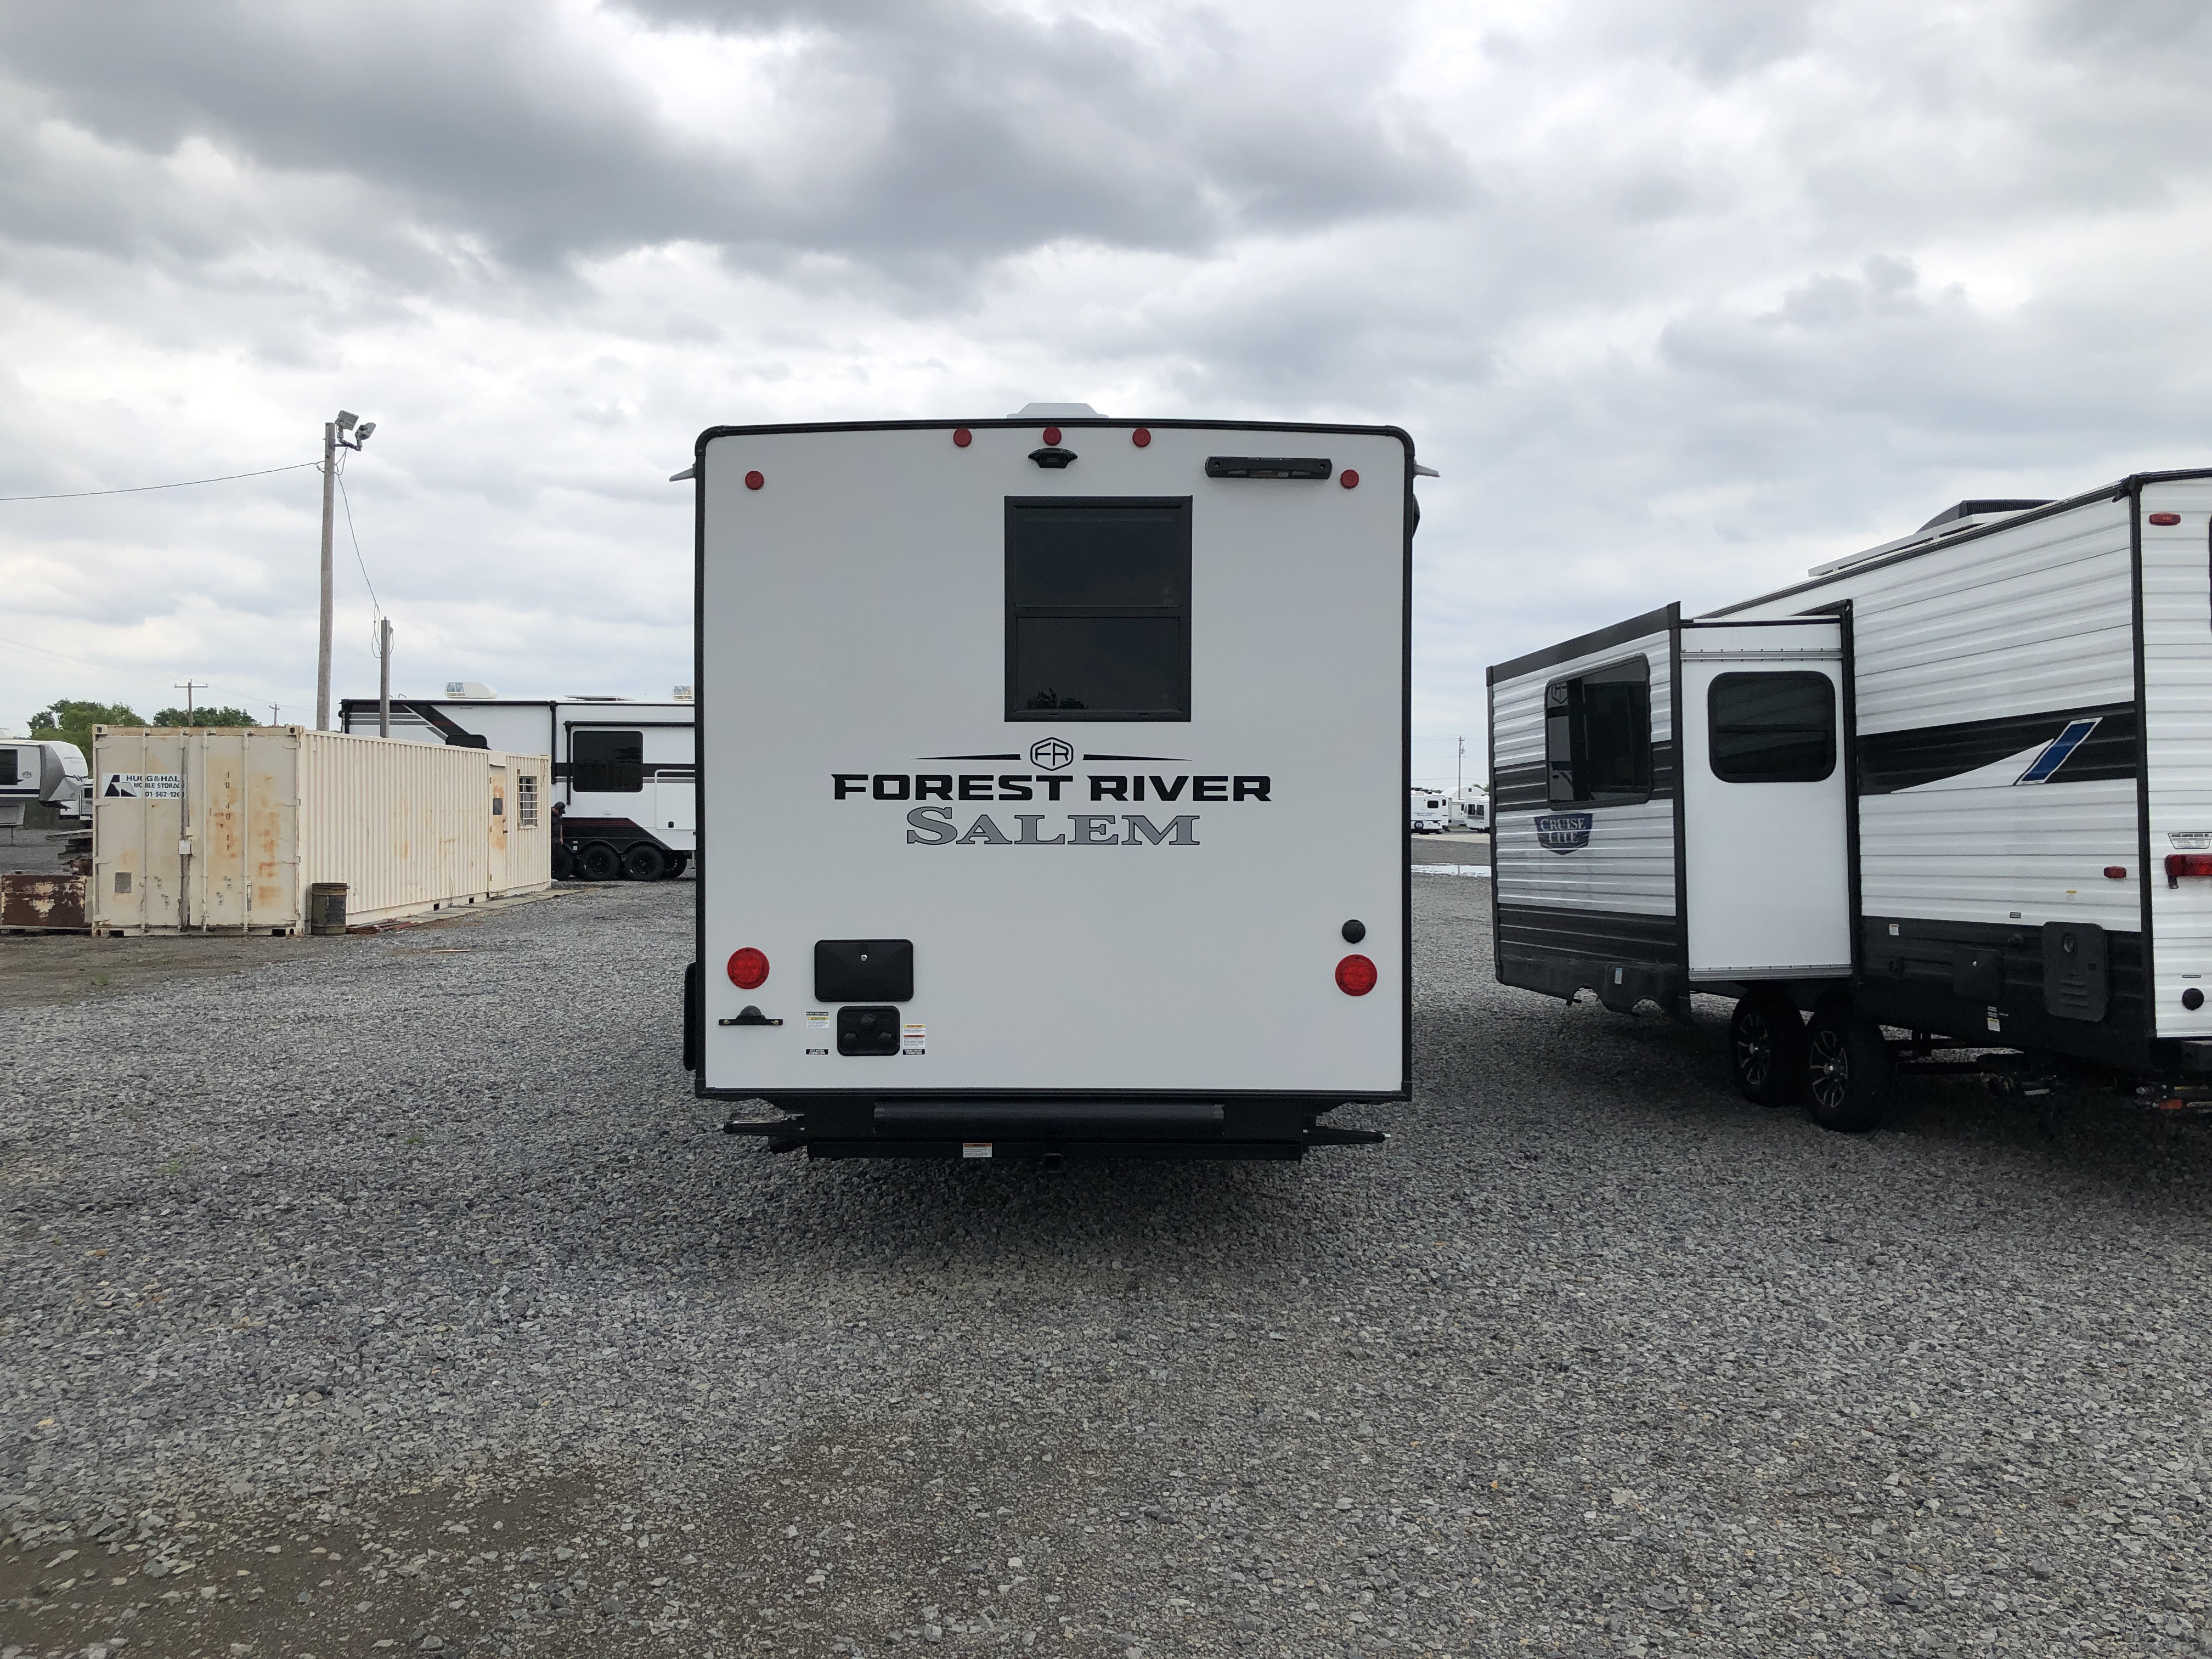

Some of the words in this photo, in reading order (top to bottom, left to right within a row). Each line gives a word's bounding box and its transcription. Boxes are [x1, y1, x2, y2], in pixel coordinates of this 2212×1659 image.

[1035, 742, 1069, 766] FR
[831, 774, 1074, 801] FOREST
[1087, 775, 1272, 802] RIVER
[907, 806, 1200, 845] SALEM
[1541, 818, 1587, 831] CRUISE
[1549, 832, 1579, 843] LITE
